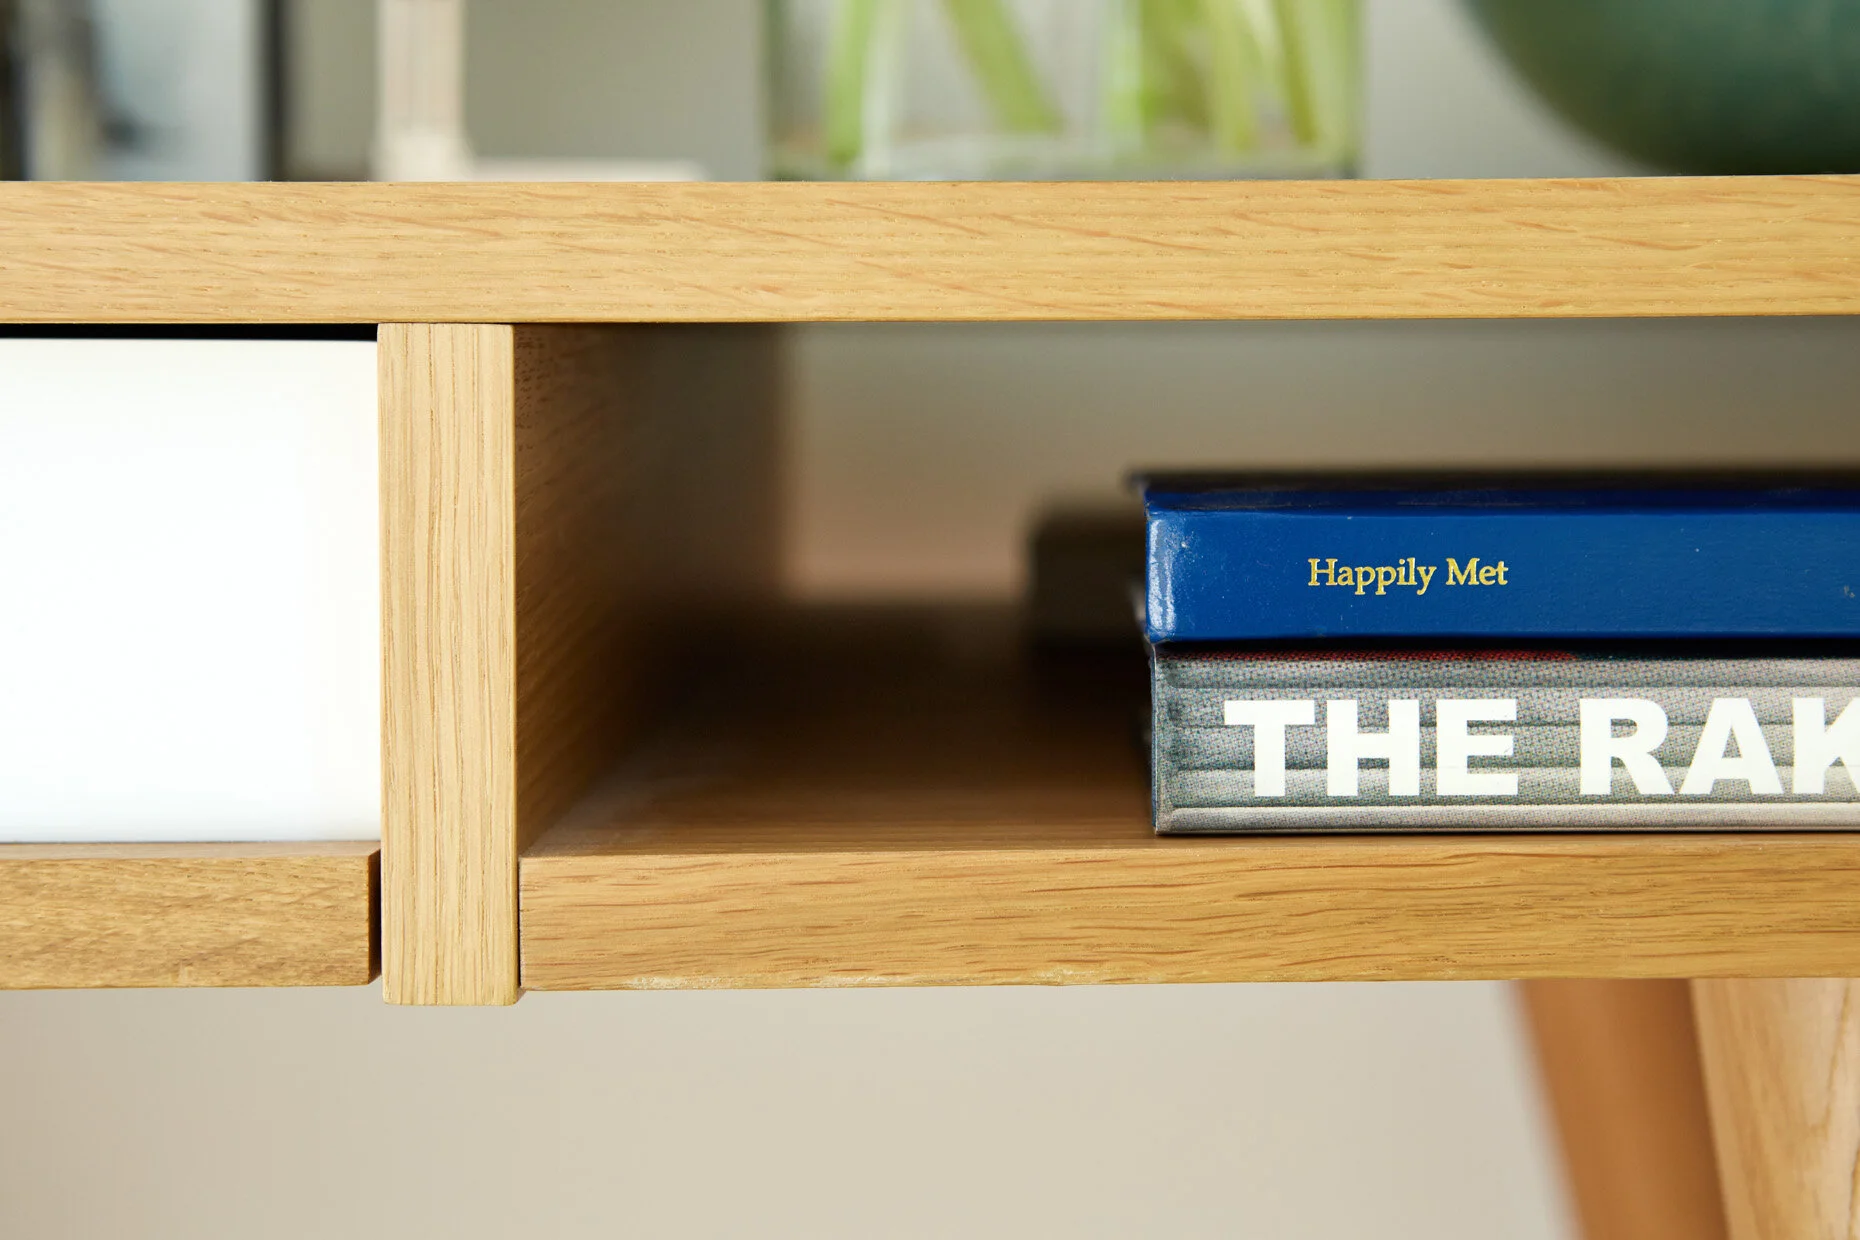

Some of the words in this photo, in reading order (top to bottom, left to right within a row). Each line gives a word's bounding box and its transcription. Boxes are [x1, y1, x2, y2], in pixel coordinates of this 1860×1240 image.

[1307, 557, 1437, 595] Happily
[1446, 557, 1509, 586] Met
[1223, 698, 1519, 797] THE
[1579, 697, 1860, 796] RAK
